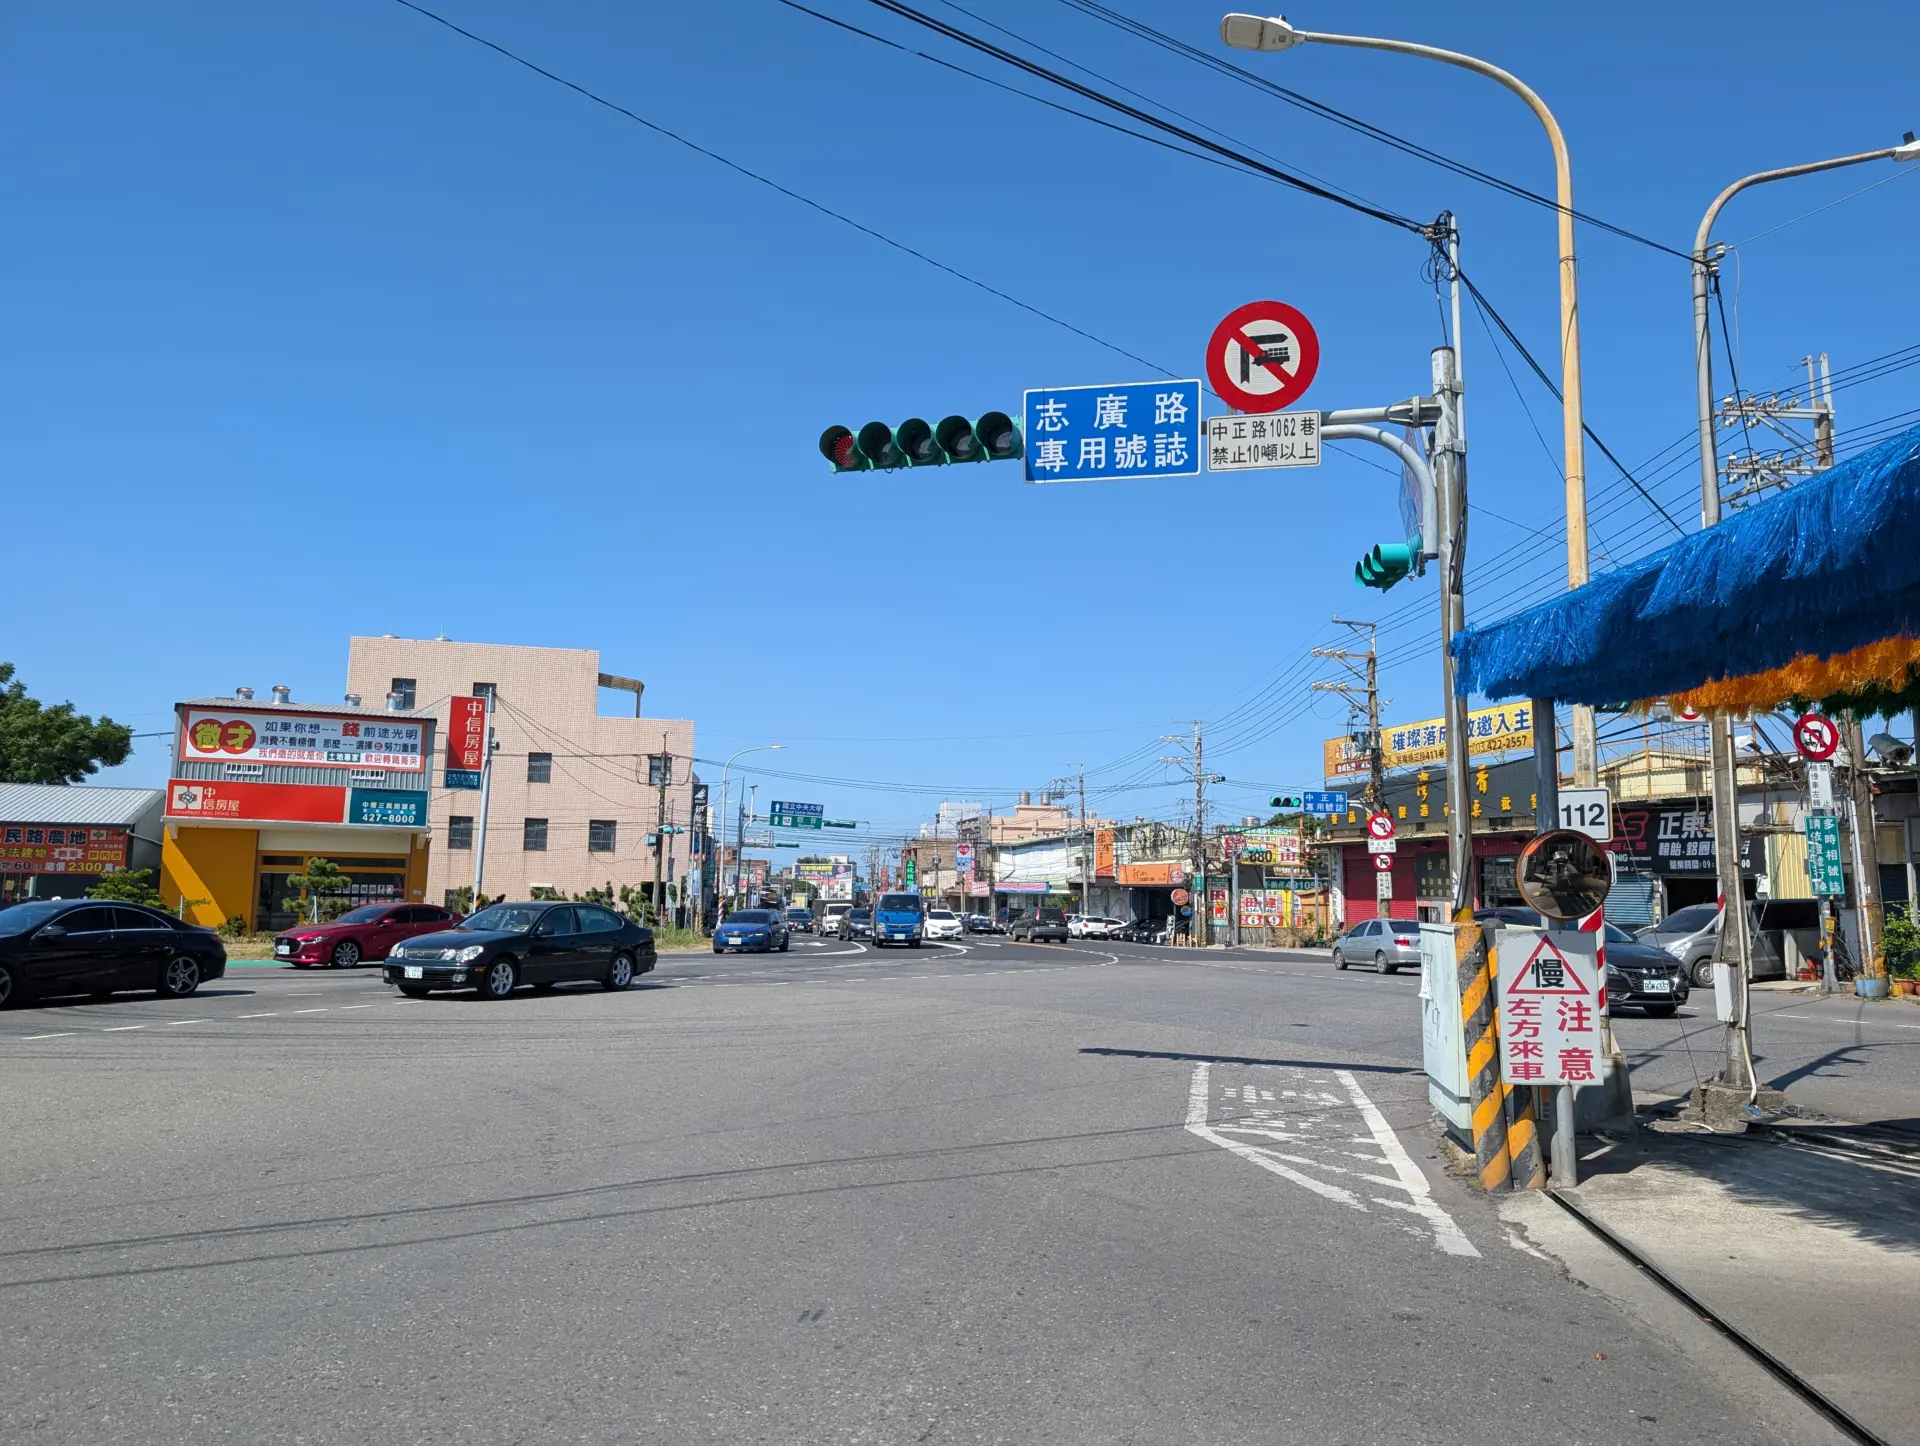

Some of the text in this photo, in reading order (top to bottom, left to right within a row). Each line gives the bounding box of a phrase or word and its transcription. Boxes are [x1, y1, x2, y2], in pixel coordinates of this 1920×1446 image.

[1035, 391, 1188, 432] 志廣路
[1212, 416, 1316, 441] 中正路1062巷
[1034, 432, 1188, 474] 專用號誌
[1212, 442, 1316, 466] 禁止10噸以上
[195, 723, 252, 749] 徵才
[463, 701, 482, 765] 中信房屋
[203, 798, 240, 811] 信房屋
[204, 787, 216, 798] 中
[1305, 793, 1344, 802] 中正路
[362, 813, 415, 824] 427-8000
[1305, 803, 1344, 812] 專用號誌
[1560, 803, 1606, 827] 112
[0, 828, 88, 845] 民路農地
[1823, 818, 1841, 892] 多時相號誌
[1530, 958, 1565, 988] 慢
[1507, 998, 1596, 1081] 注意 左方來車
